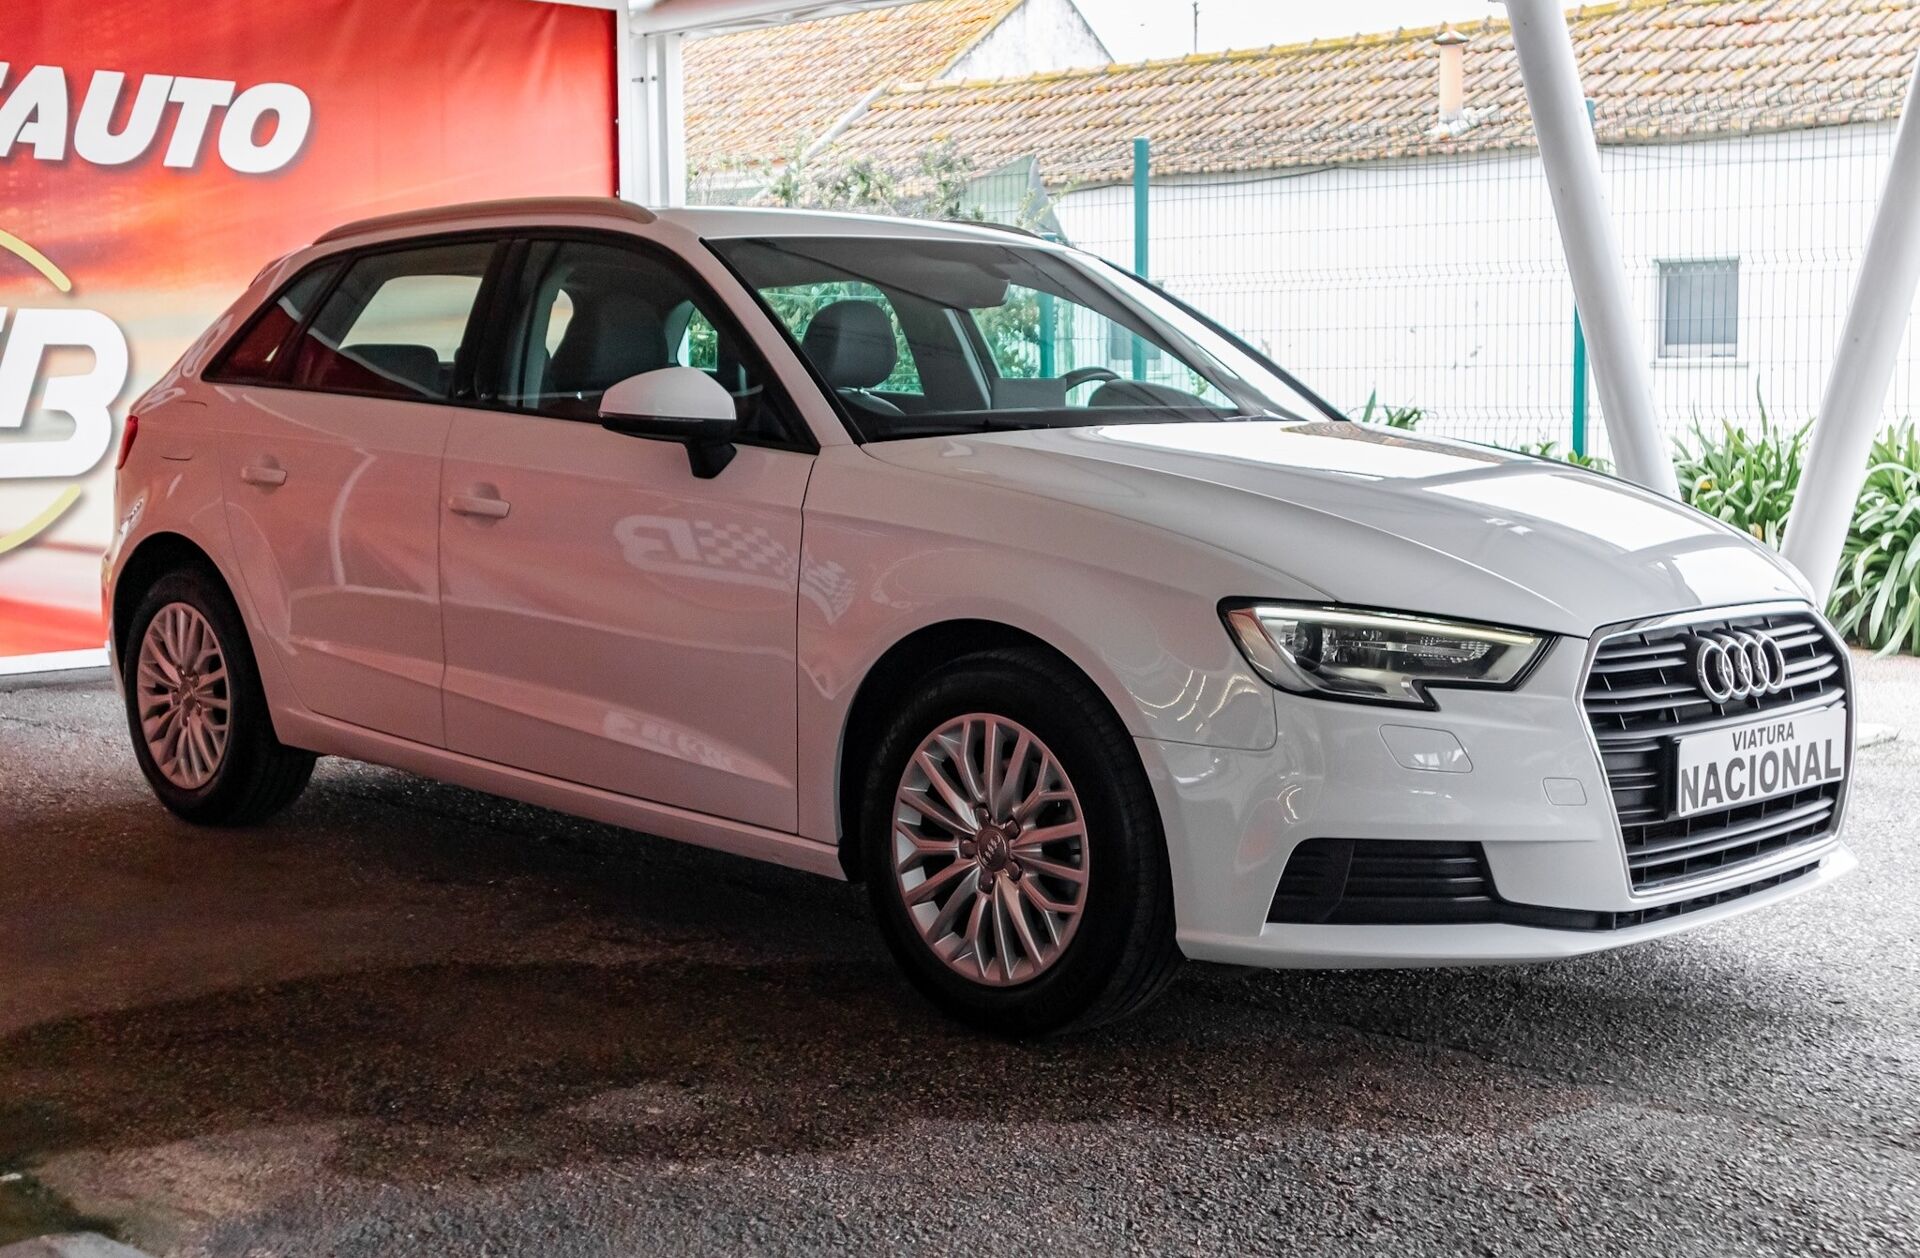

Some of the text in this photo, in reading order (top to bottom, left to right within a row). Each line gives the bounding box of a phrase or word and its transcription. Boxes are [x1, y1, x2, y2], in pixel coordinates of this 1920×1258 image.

[0, 61, 311, 173] AUTO
[1732, 721, 1795, 751] VIATURA
[1681, 739, 1842, 812] NACIONAL
